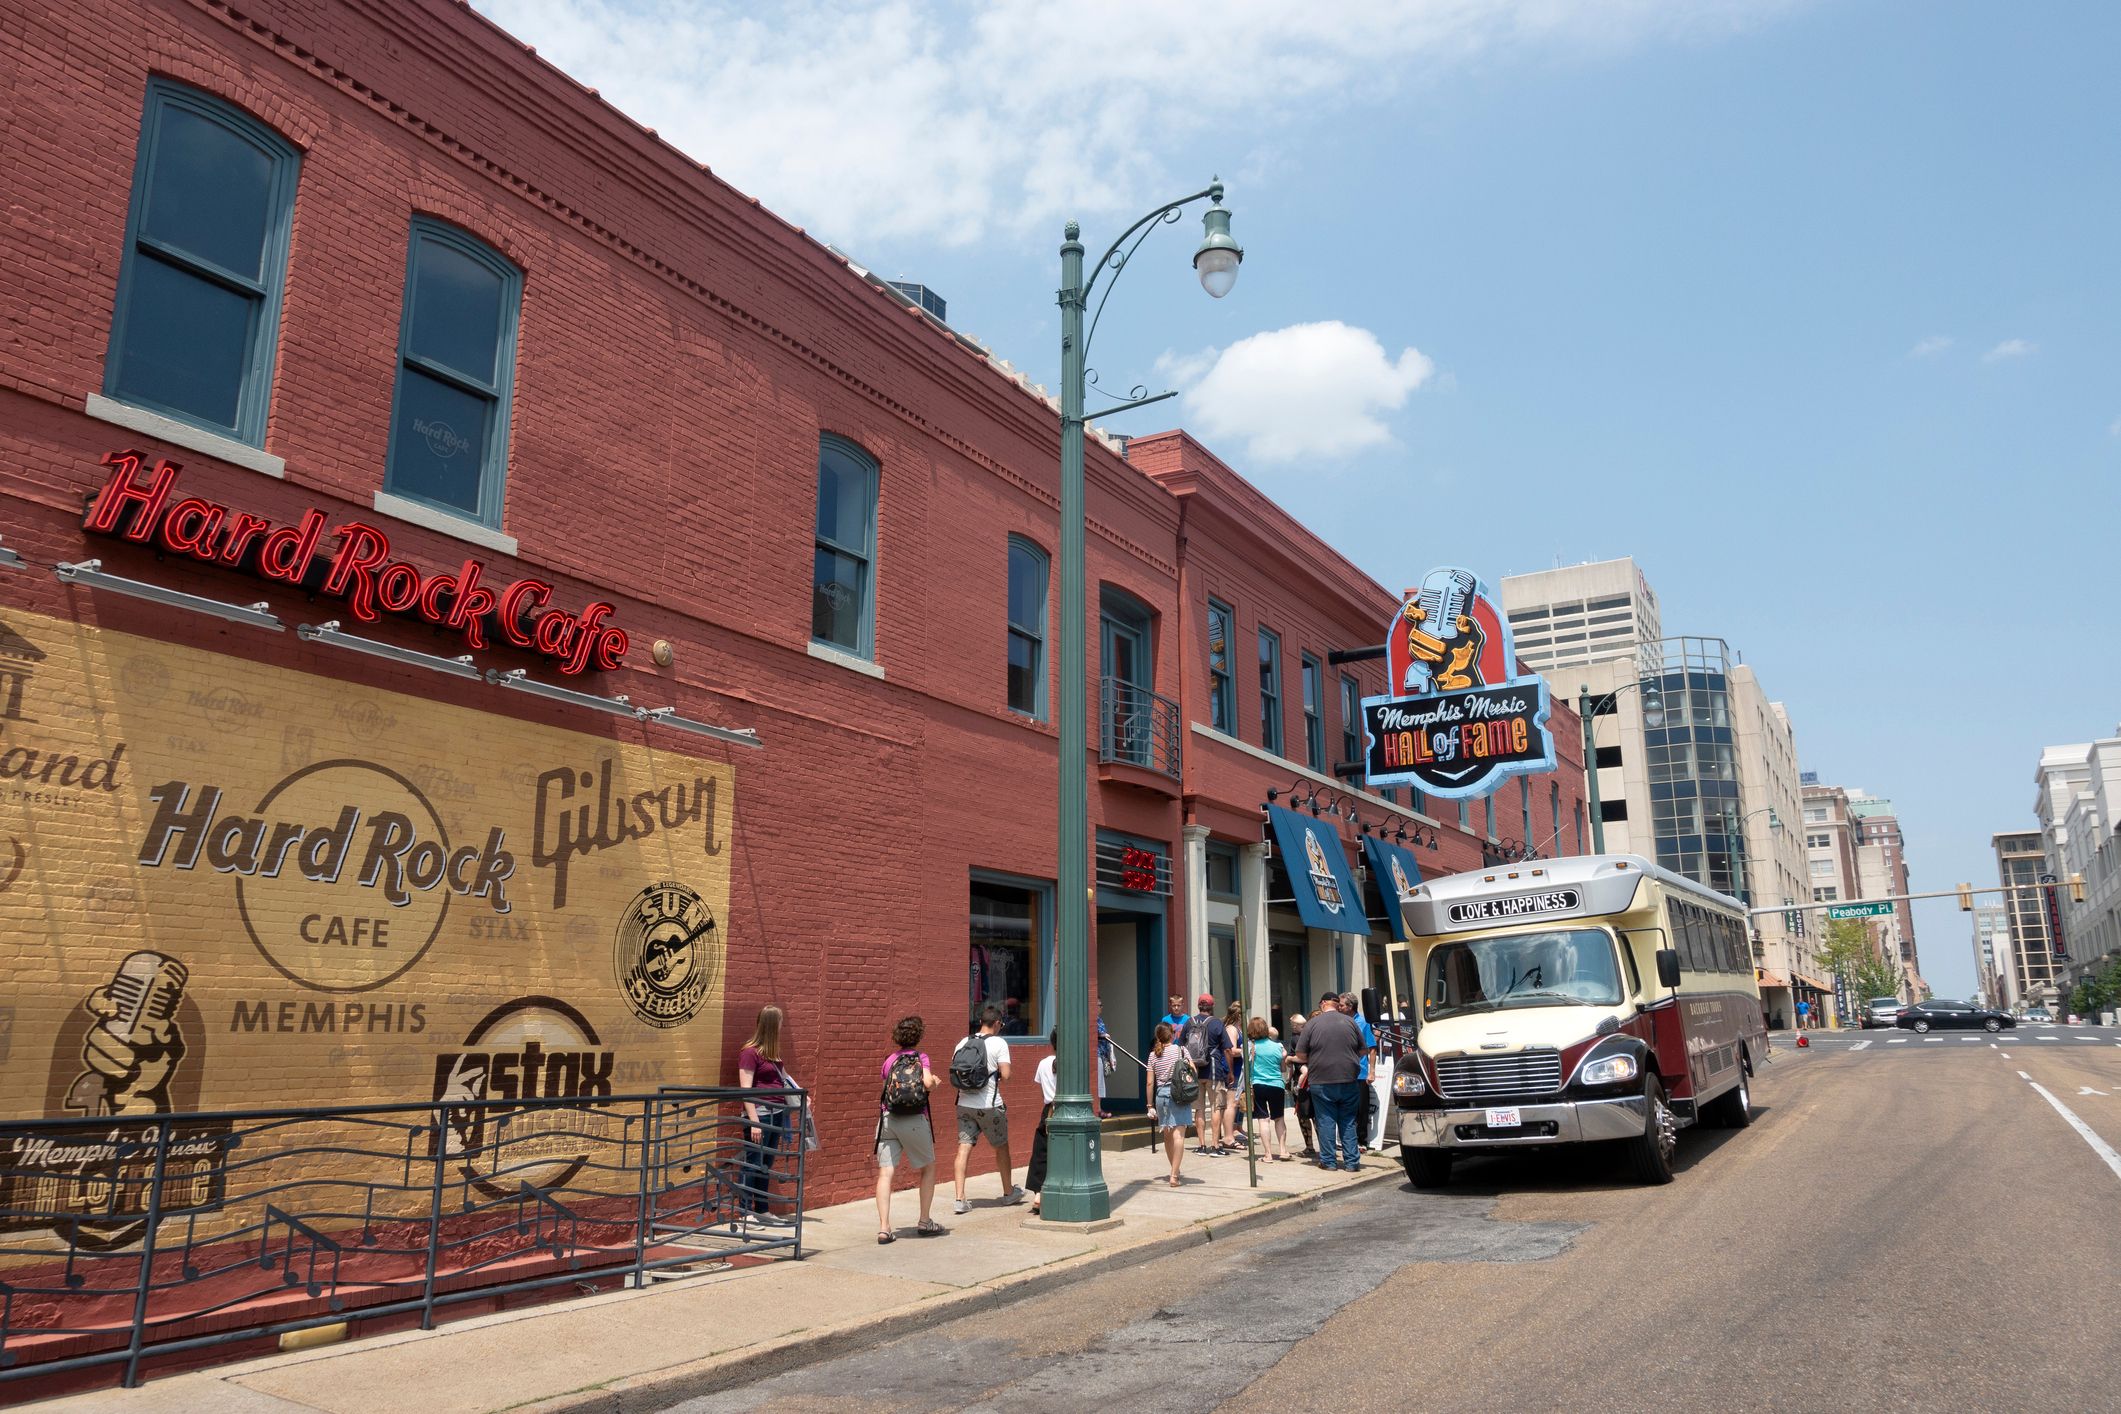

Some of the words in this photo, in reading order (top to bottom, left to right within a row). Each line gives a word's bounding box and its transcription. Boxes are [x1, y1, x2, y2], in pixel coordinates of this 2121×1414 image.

[84, 449, 329, 585] Hard
[322, 522, 497, 649] Rock
[497, 578, 630, 675] Cafe
[1377, 699, 1463, 731] Memphis
[1464, 694, 1527, 718] Music
[1384, 729, 1434, 768] HALL
[1433, 725, 1459, 761] of
[0, 743, 127, 792] and
[12, 789, 82, 808] PRESLEY
[137, 780, 361, 883] Hard
[357, 810, 516, 914] Rock
[533, 758, 722, 910] Gibson
[640, 892, 704, 931] SUN
[1459, 903, 1489, 920] LOVE
[1491, 901, 1500, 916] &
[1502, 893, 1567, 915] HAPPINESS
[1832, 905, 1873, 918] Peabody
[299, 913, 390, 948] CAFE
[469, 915, 530, 942] STAX
[630, 978, 701, 1016] Studio
[230, 1000, 426, 1033] MEMPHIS
[615, 1060, 667, 1084] STAX
